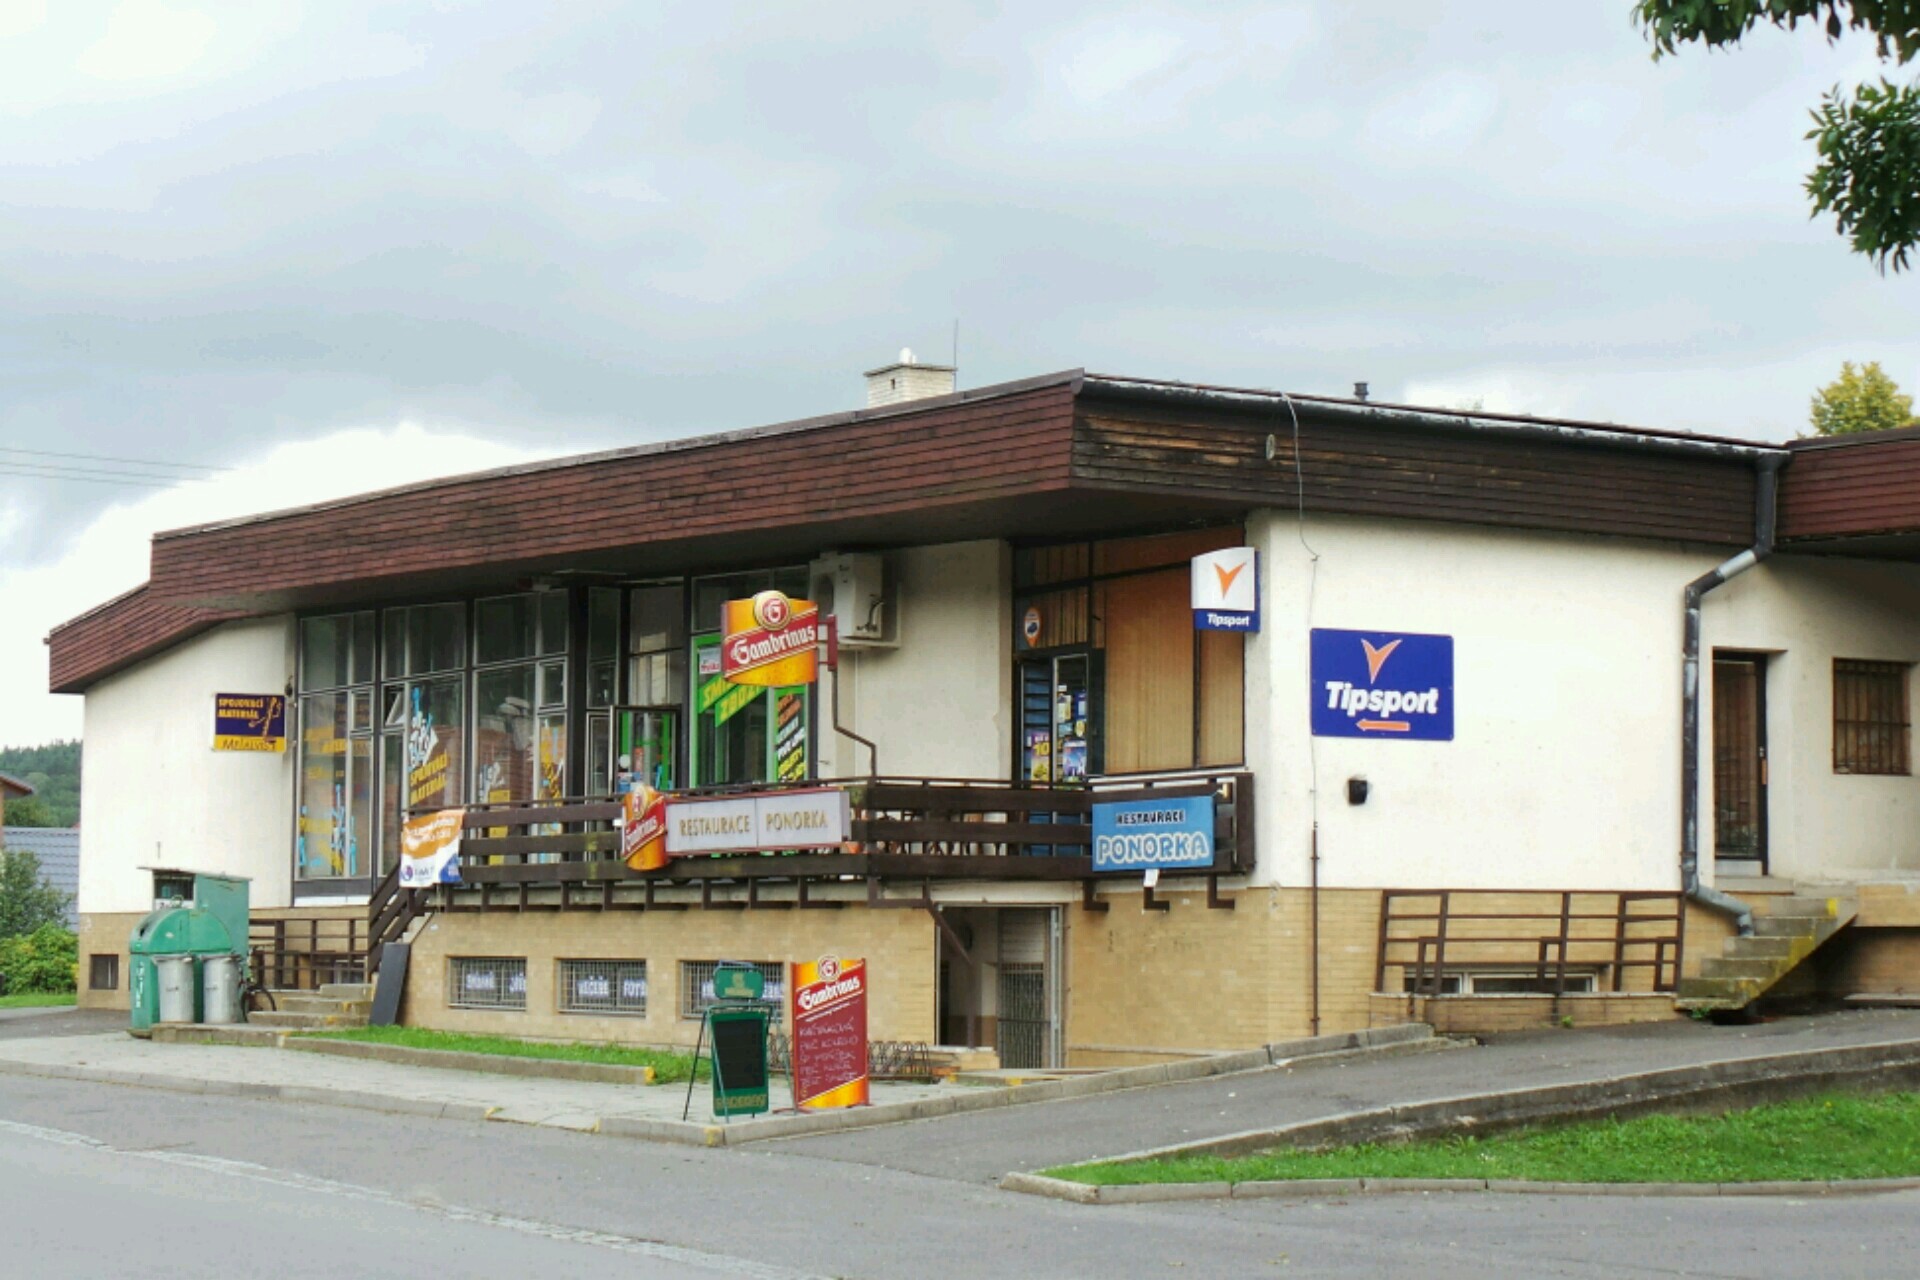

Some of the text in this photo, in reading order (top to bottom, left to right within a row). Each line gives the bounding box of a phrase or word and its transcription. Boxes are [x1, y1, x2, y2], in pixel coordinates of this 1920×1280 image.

[1207, 612, 1250, 628] Tipsport
[730, 626, 816, 665] Gambrinus
[1325, 681, 1439, 718] Tipsport
[679, 810, 828, 837] RESTAURACE PONORKA
[1095, 831, 1210, 865] PONORKA
[798, 976, 860, 1010] Gambrinus
